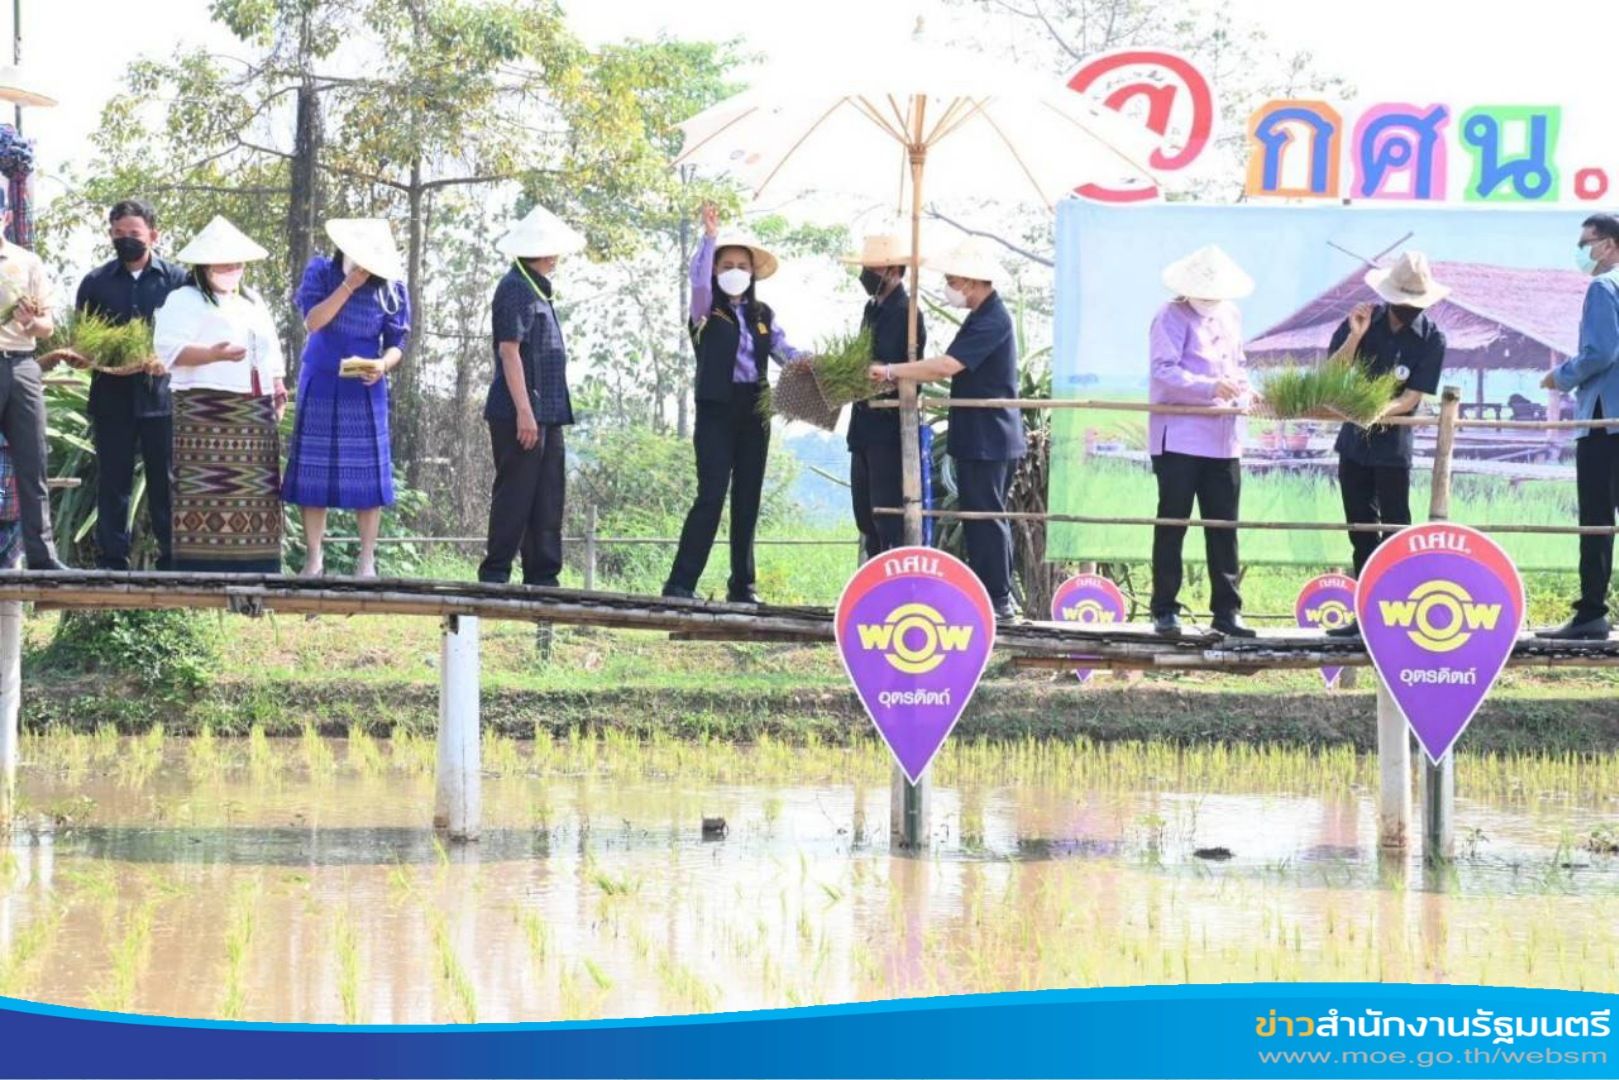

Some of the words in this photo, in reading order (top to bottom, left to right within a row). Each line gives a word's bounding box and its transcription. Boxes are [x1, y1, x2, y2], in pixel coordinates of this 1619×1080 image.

[1250, 102, 1608, 202] กศน.
[1408, 531, 1472, 554] กศน.
[884, 554, 945, 578] กศน.
[1400, 667, 1477, 687] อุตรดิตถ์
